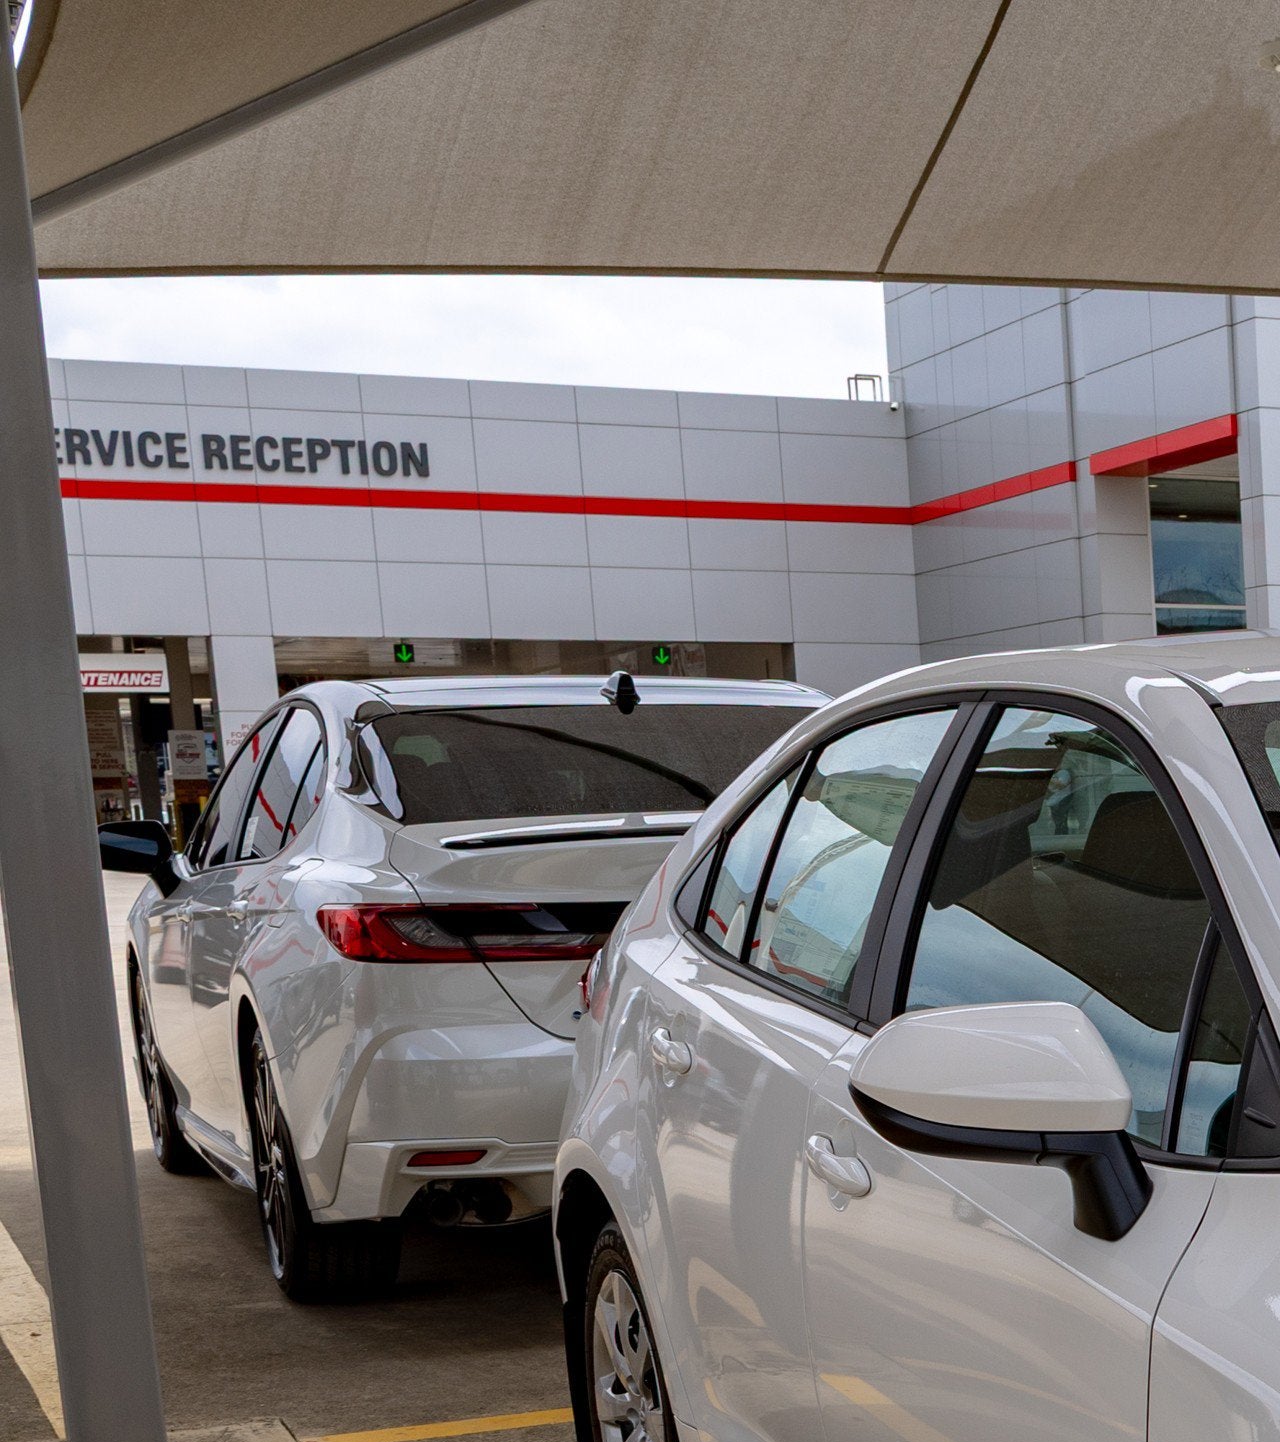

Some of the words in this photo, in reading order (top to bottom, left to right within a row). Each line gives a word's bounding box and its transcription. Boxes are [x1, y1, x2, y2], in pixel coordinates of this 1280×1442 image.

[54, 428, 190, 469] RVICE
[201, 433, 431, 478] RECEPTION
[80, 672, 162, 686] NTENANCE
